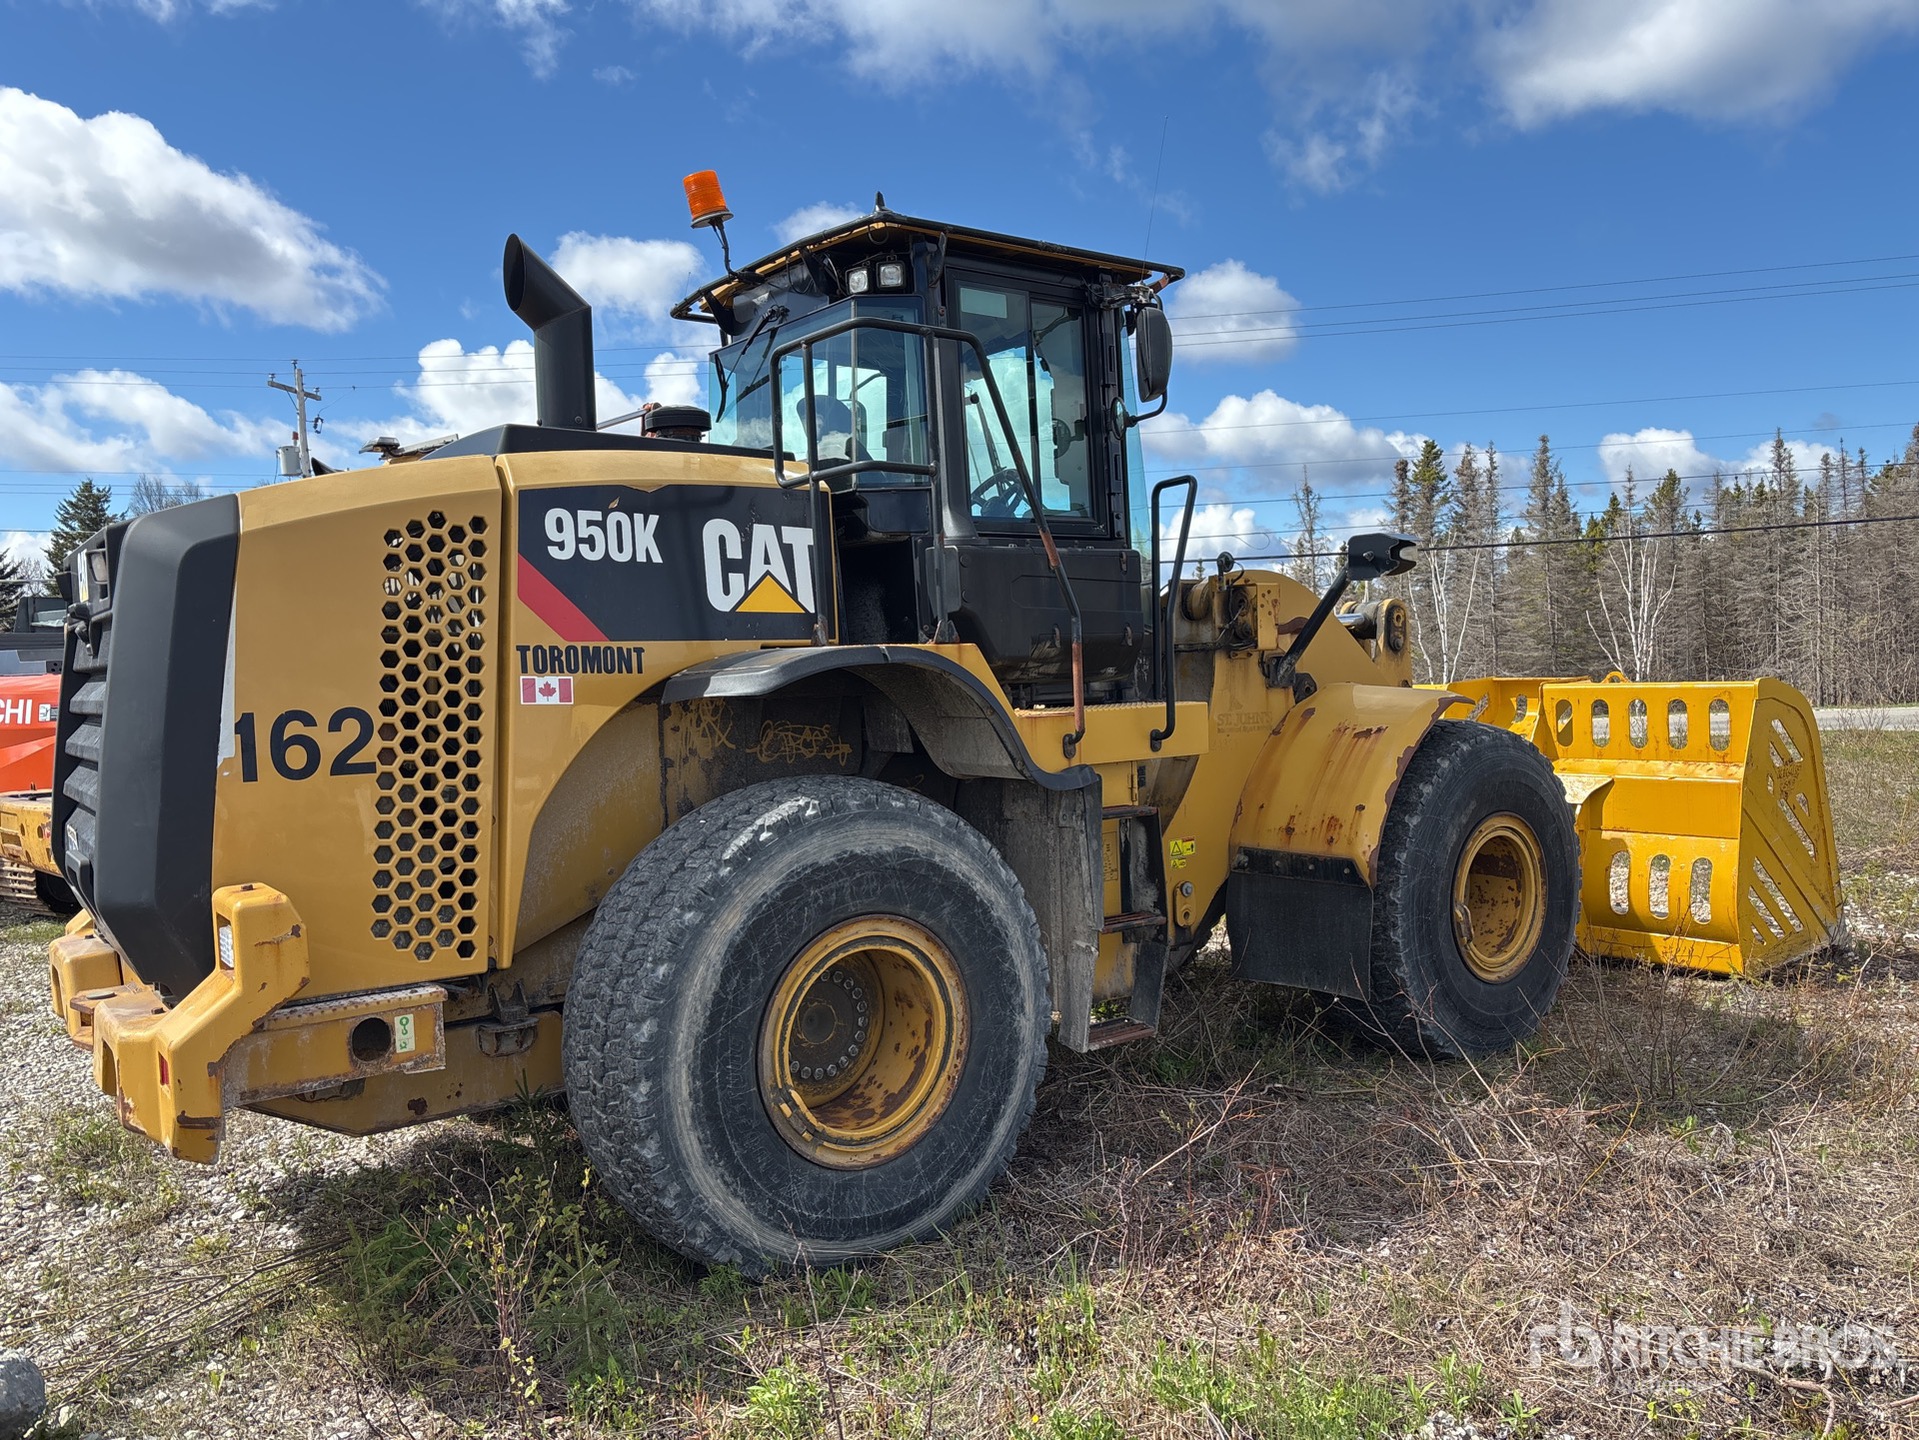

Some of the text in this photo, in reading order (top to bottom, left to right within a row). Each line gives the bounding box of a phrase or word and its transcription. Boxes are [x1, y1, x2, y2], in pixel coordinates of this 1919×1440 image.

[544, 508, 663, 564] 950K
[702, 518, 815, 613] CAT
[516, 645, 645, 674] TOROMONT
[235, 706, 377, 783] 162
